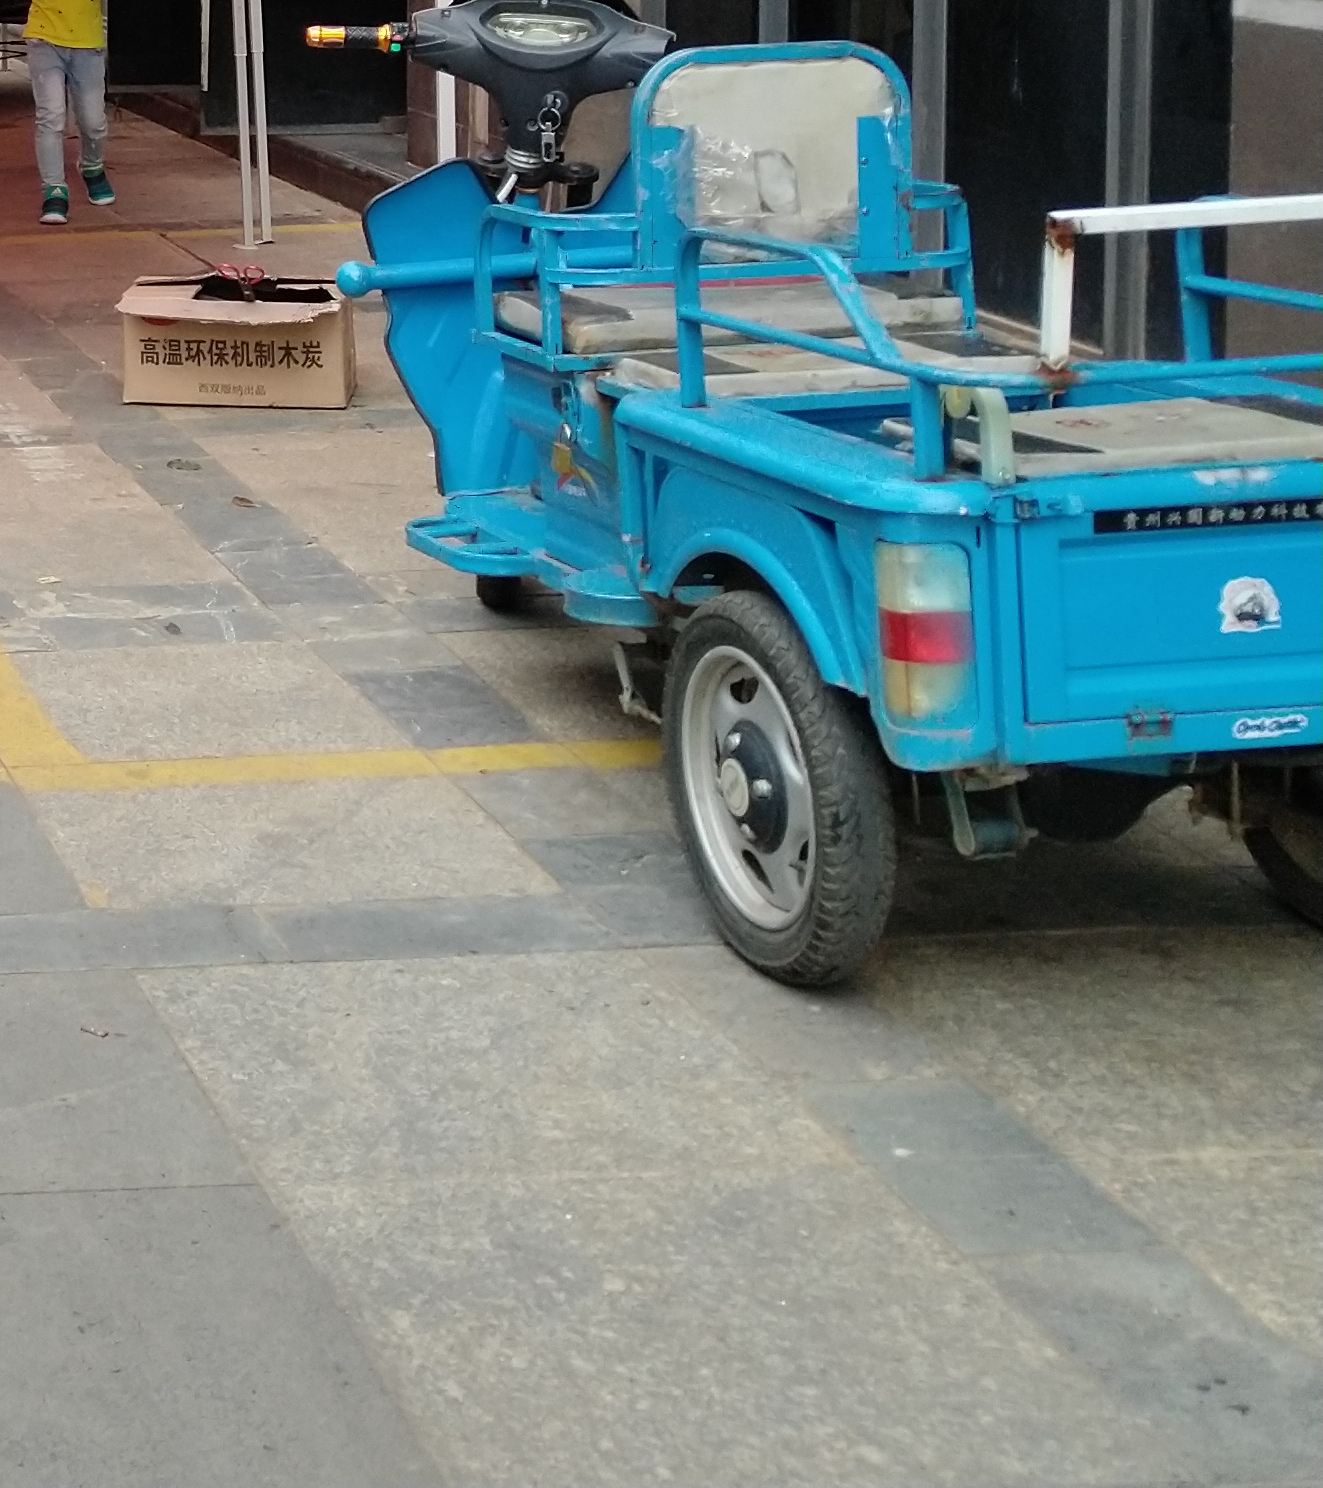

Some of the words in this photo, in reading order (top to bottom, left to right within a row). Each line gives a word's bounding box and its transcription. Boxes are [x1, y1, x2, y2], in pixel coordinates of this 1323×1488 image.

[139, 337, 324, 370] 高温环保机制木炭
[198, 382, 266, 397] 西双版纳出品
